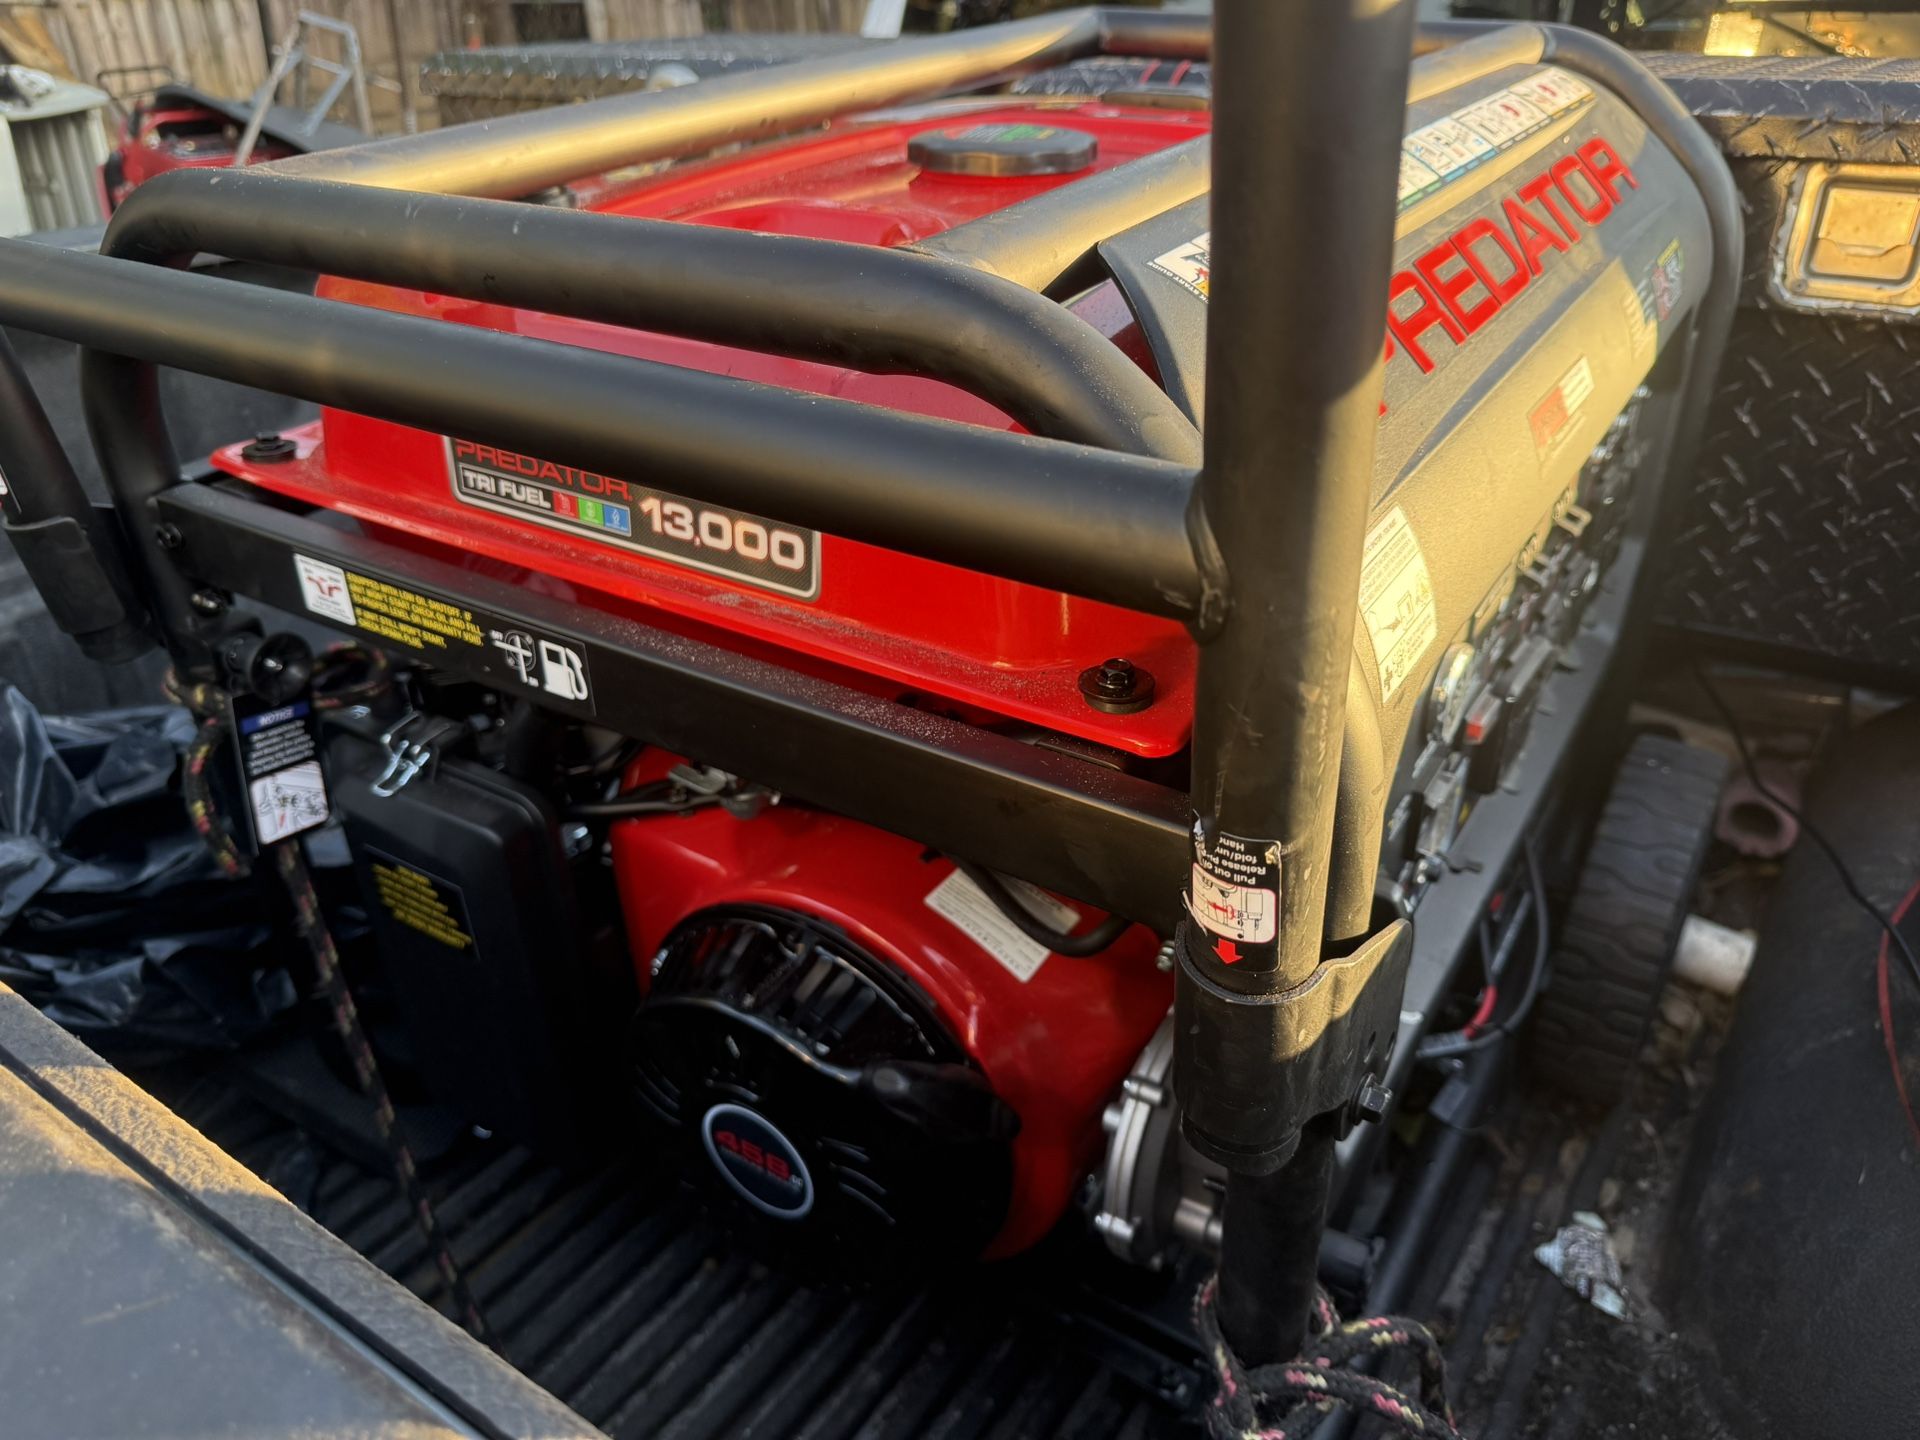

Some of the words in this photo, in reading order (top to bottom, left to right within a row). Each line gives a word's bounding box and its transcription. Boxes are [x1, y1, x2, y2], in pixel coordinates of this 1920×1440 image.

[463, 470, 496, 494] TRI
[498, 479, 552, 508] FUEL
[639, 497, 805, 571] 13,000
[1214, 865, 1231, 878] out
[1221, 859, 1266, 875] Release
[1233, 873, 1256, 885] Pull
